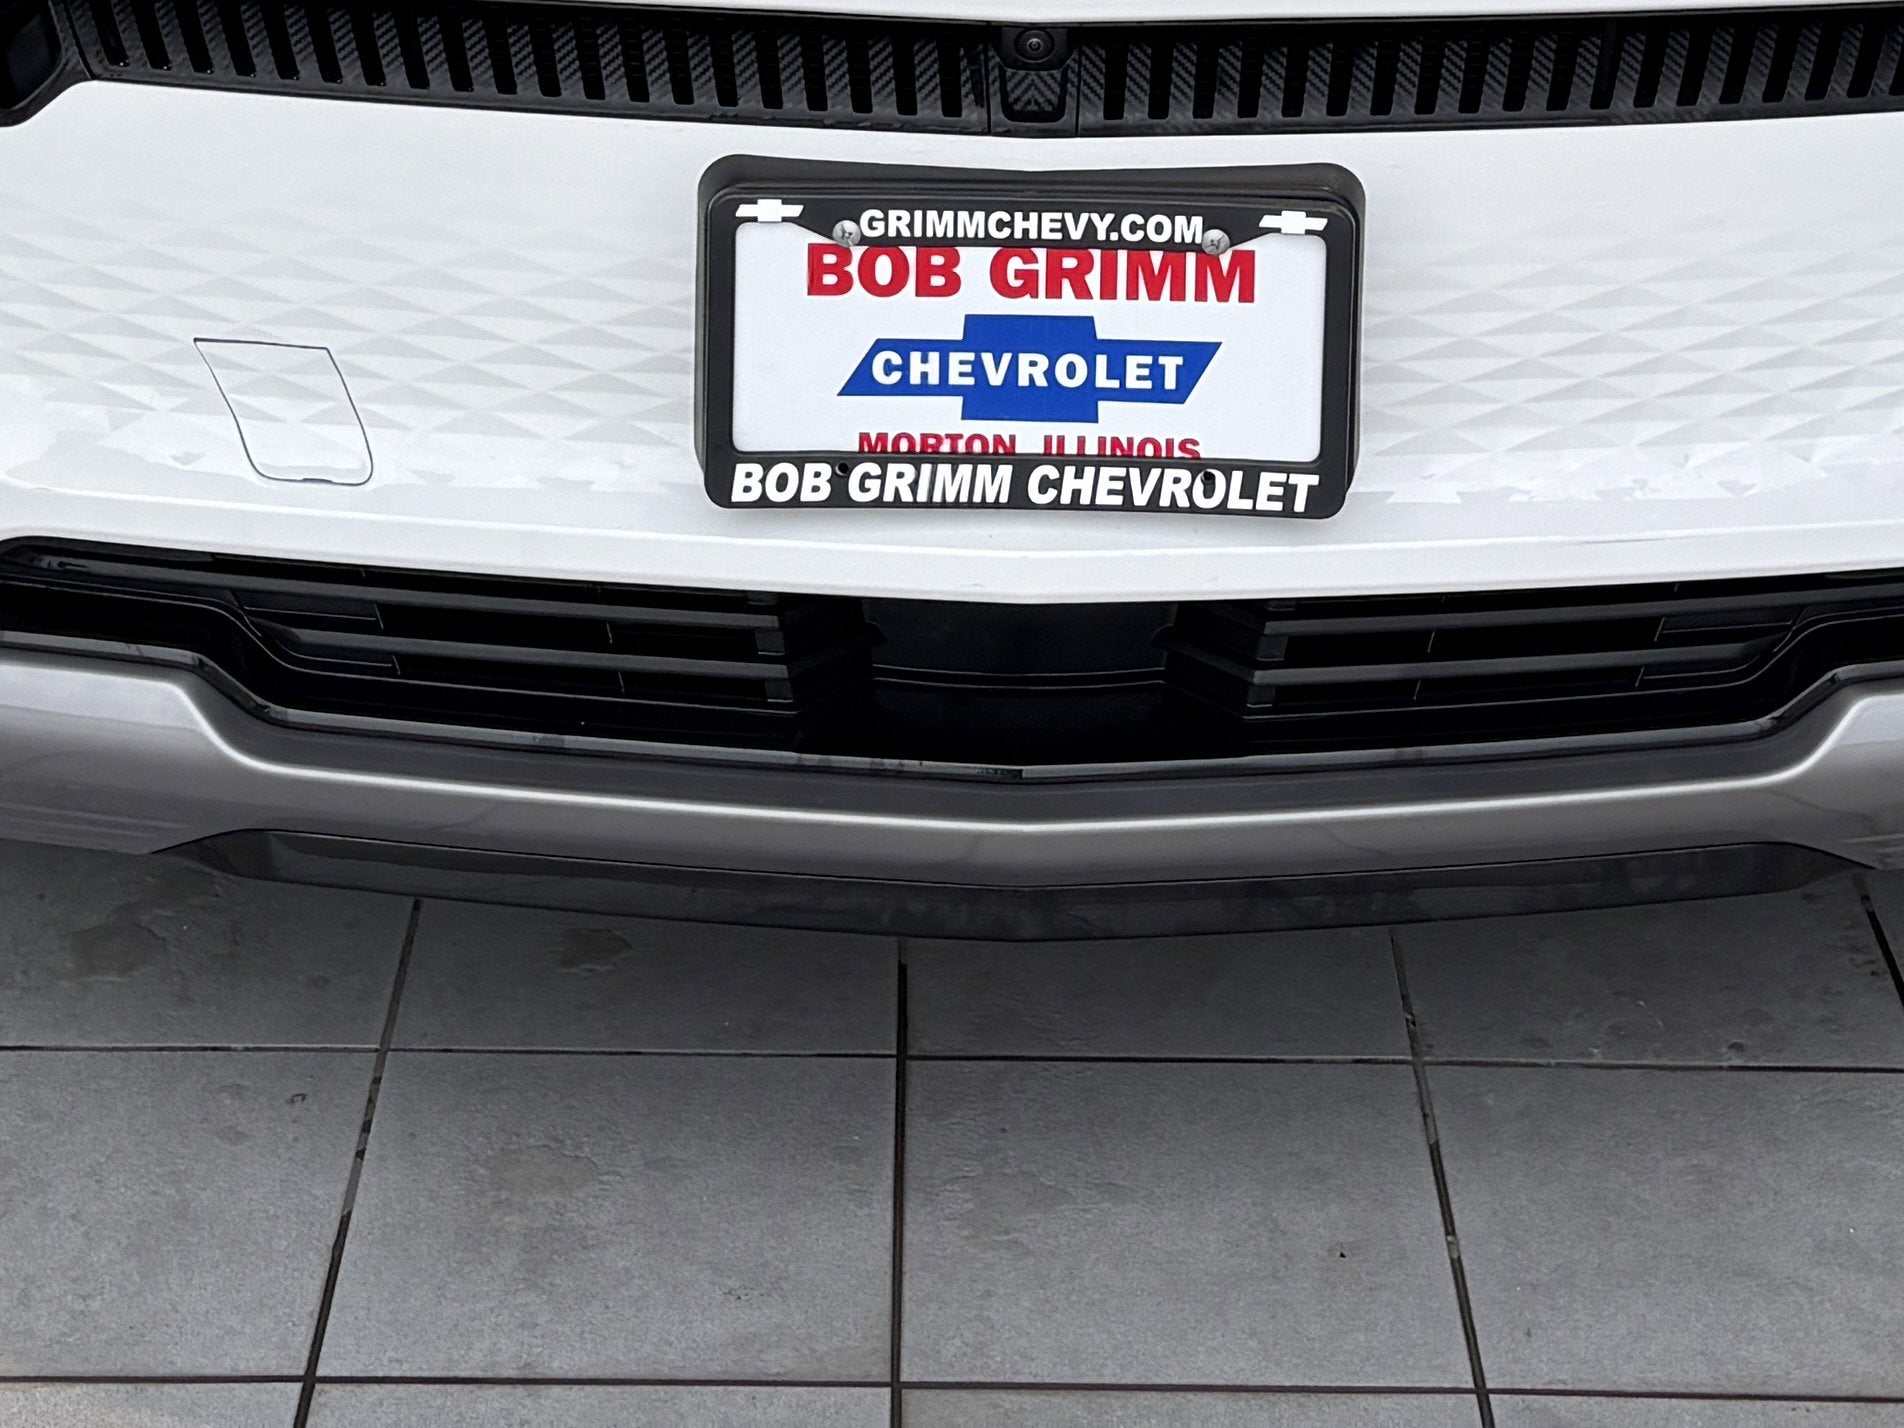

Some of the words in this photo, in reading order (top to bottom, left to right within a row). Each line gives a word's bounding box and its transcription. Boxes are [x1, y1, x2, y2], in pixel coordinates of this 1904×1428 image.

[858, 209, 1204, 244] GRIMMCHEVY.COM
[806, 243, 962, 298] BOB
[989, 246, 1256, 304] GRIMM
[871, 350, 1184, 390] CHEVROLET
[858, 432, 1016, 456] MORTON
[730, 461, 833, 503] BOB
[847, 461, 1014, 504] GRIMM
[1026, 463, 1320, 514] CHEVROLET
